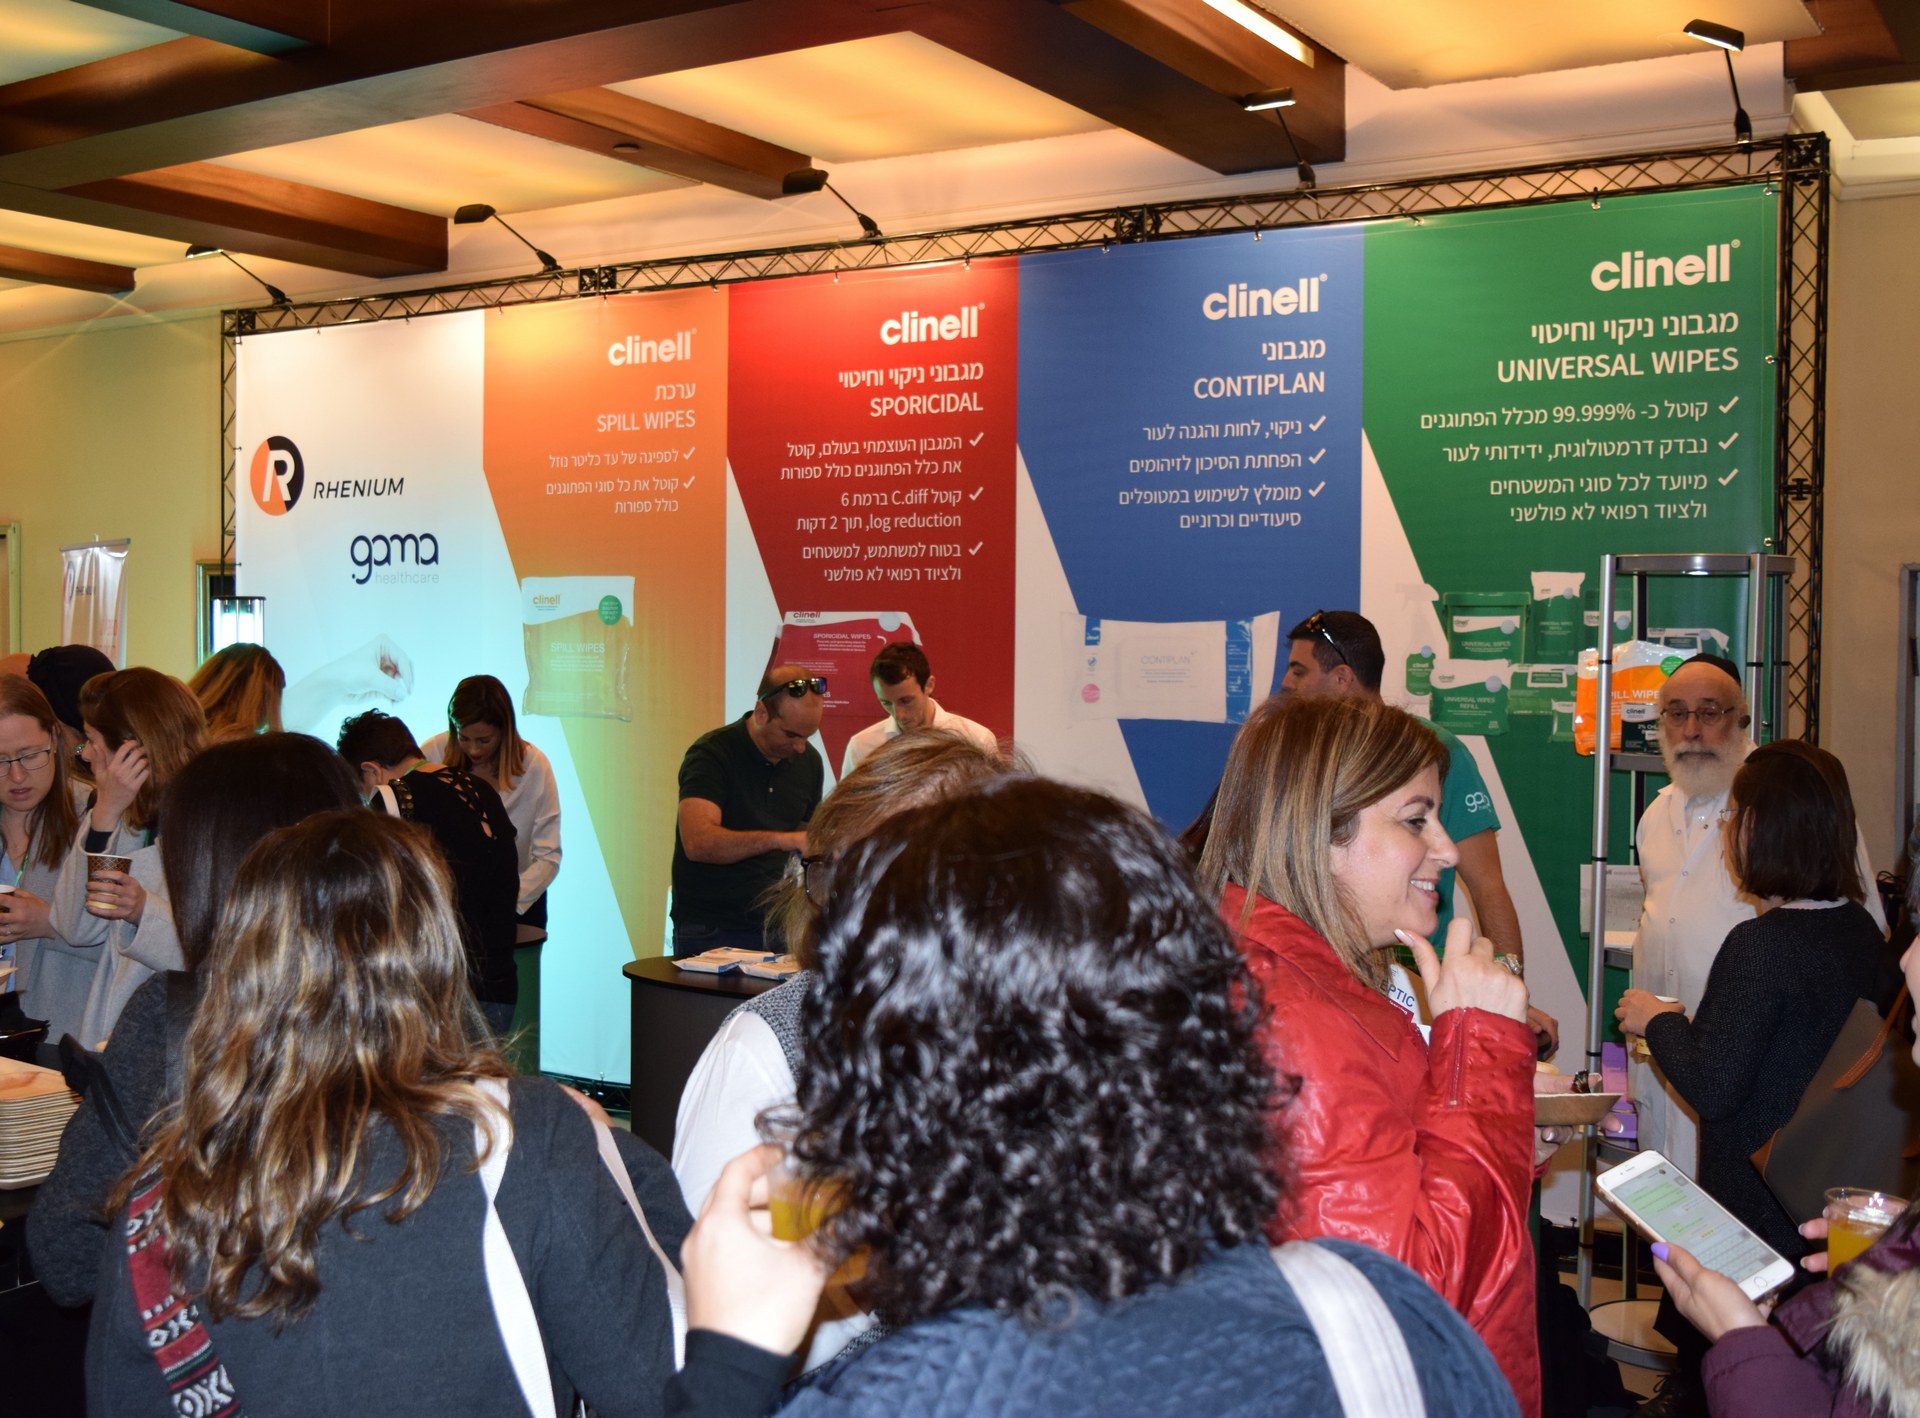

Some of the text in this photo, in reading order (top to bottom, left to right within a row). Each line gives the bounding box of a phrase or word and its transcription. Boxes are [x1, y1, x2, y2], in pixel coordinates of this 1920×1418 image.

[1532, 312, 1739, 345] מגבוני ניקוי וחיטוי
[1262, 339, 1326, 360] מגבוני
[1497, 348, 1739, 383] UNIVERSAL WIPES
[839, 363, 983, 389] מגבוני ניקוי וחיטוי
[655, 383, 695, 400] ערכת
[1194, 371, 1325, 399] CONTIPLAN
[870, 392, 983, 417] SPORICIDAL
[1553, 403, 1636, 423] 99.999%
[1664, 401, 1708, 422] קוטל
[597, 410, 695, 433] SPILL WIPES
[1421, 410, 1497, 429] הפתוגנים
[1501, 407, 1548, 426] מכלל
[1143, 424, 1175, 440] לעור
[1179, 424, 1219, 438] והגנה
[1223, 420, 1260, 437] לחות
[788, 441, 815, 459] קוטל
[863, 438, 916, 454] העוצמתי
[920, 436, 962, 454] המגבון
[1443, 443, 1480, 462] לעור
[1485, 443, 1543, 460] ידידותי
[1660, 438, 1708, 459] נבדק
[549, 449, 678, 468] לספיגה של עד כליטר נוזל
[942, 460, 961, 473] את
[1130, 452, 1301, 474] הפחתת הסיכון לזיהומים
[781, 466, 822, 480] ספורות
[825, 463, 851, 478] כולל
[855, 462, 911, 477] הפתוגנים
[313, 477, 404, 499] RHENIUM
[547, 477, 678, 494] קוטל את כל סוגי הפתוגנים
[1490, 473, 1708, 495] מיועד לכל סוגי המשטחים
[841, 488, 962, 506] קוטל C.diff ברמת 6
[1119, 484, 1301, 505] מומלץ לשימוש במטופלים
[615, 498, 678, 513] כולל ספורות
[1510, 501, 1707, 522] ולציוד רפואי לא פולשני
[797, 517, 826, 532] דקות
[830, 516, 837, 530] 2
[842, 517, 862, 533] תוך
[895, 514, 961, 529] reduction
[1180, 512, 1301, 528] סיעודיים וכרוניים
[802, 545, 860, 559] למשטחים
[929, 543, 961, 557] בטוח
[350, 533, 439, 585] gama
[376, 572, 439, 585] healthcare
[824, 566, 961, 581] ולציוד רפואי לא פולשני
[533, 595, 560, 604] clinell
[551, 643, 605, 653] SPILL WIPES
